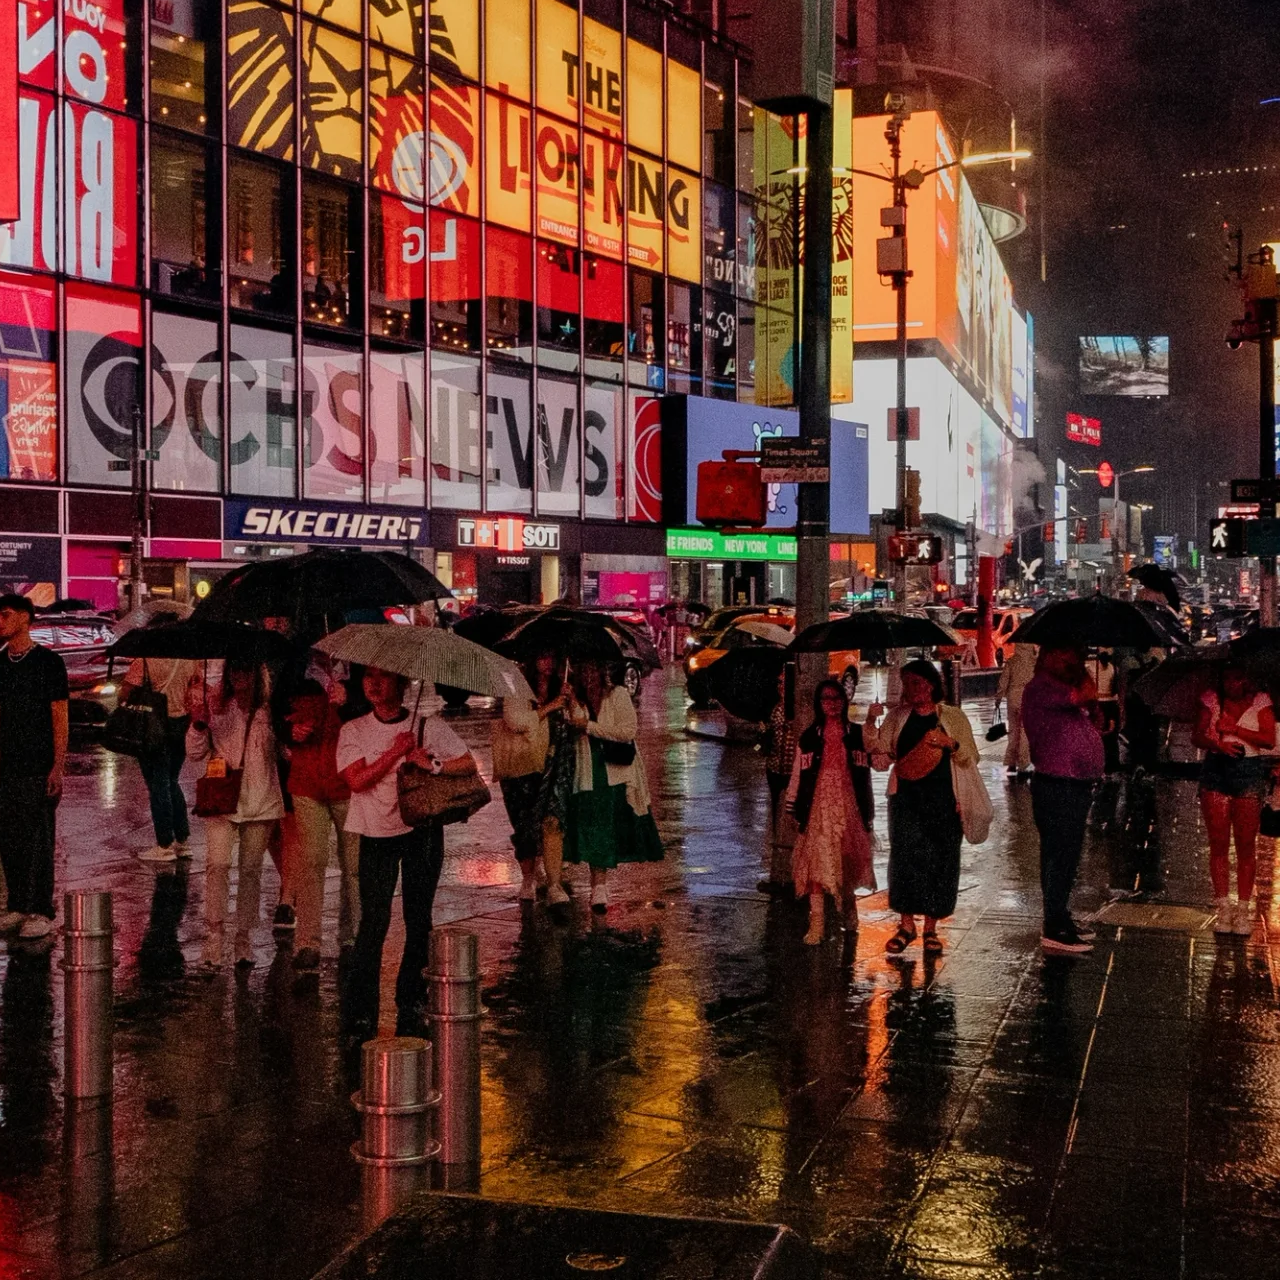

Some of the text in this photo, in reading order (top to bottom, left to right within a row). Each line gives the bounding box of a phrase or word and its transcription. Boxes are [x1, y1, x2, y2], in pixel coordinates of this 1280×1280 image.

[562, 50, 621, 117] THE
[499, 82, 690, 231] LION KING
[540, 219, 649, 261] ENTRANCE ON 45TH STREET
[832, 275, 848, 285] OCK
[184, 349, 610, 497] CBS NEWS
[764, 448, 818, 457] Times Square
[241, 508, 422, 541] SKECHERS
[677, 535, 714, 552] FRIENDS
[725, 539, 744, 553] NEW
[746, 540, 767, 554] YORK
[778, 542, 794, 554] LINE
